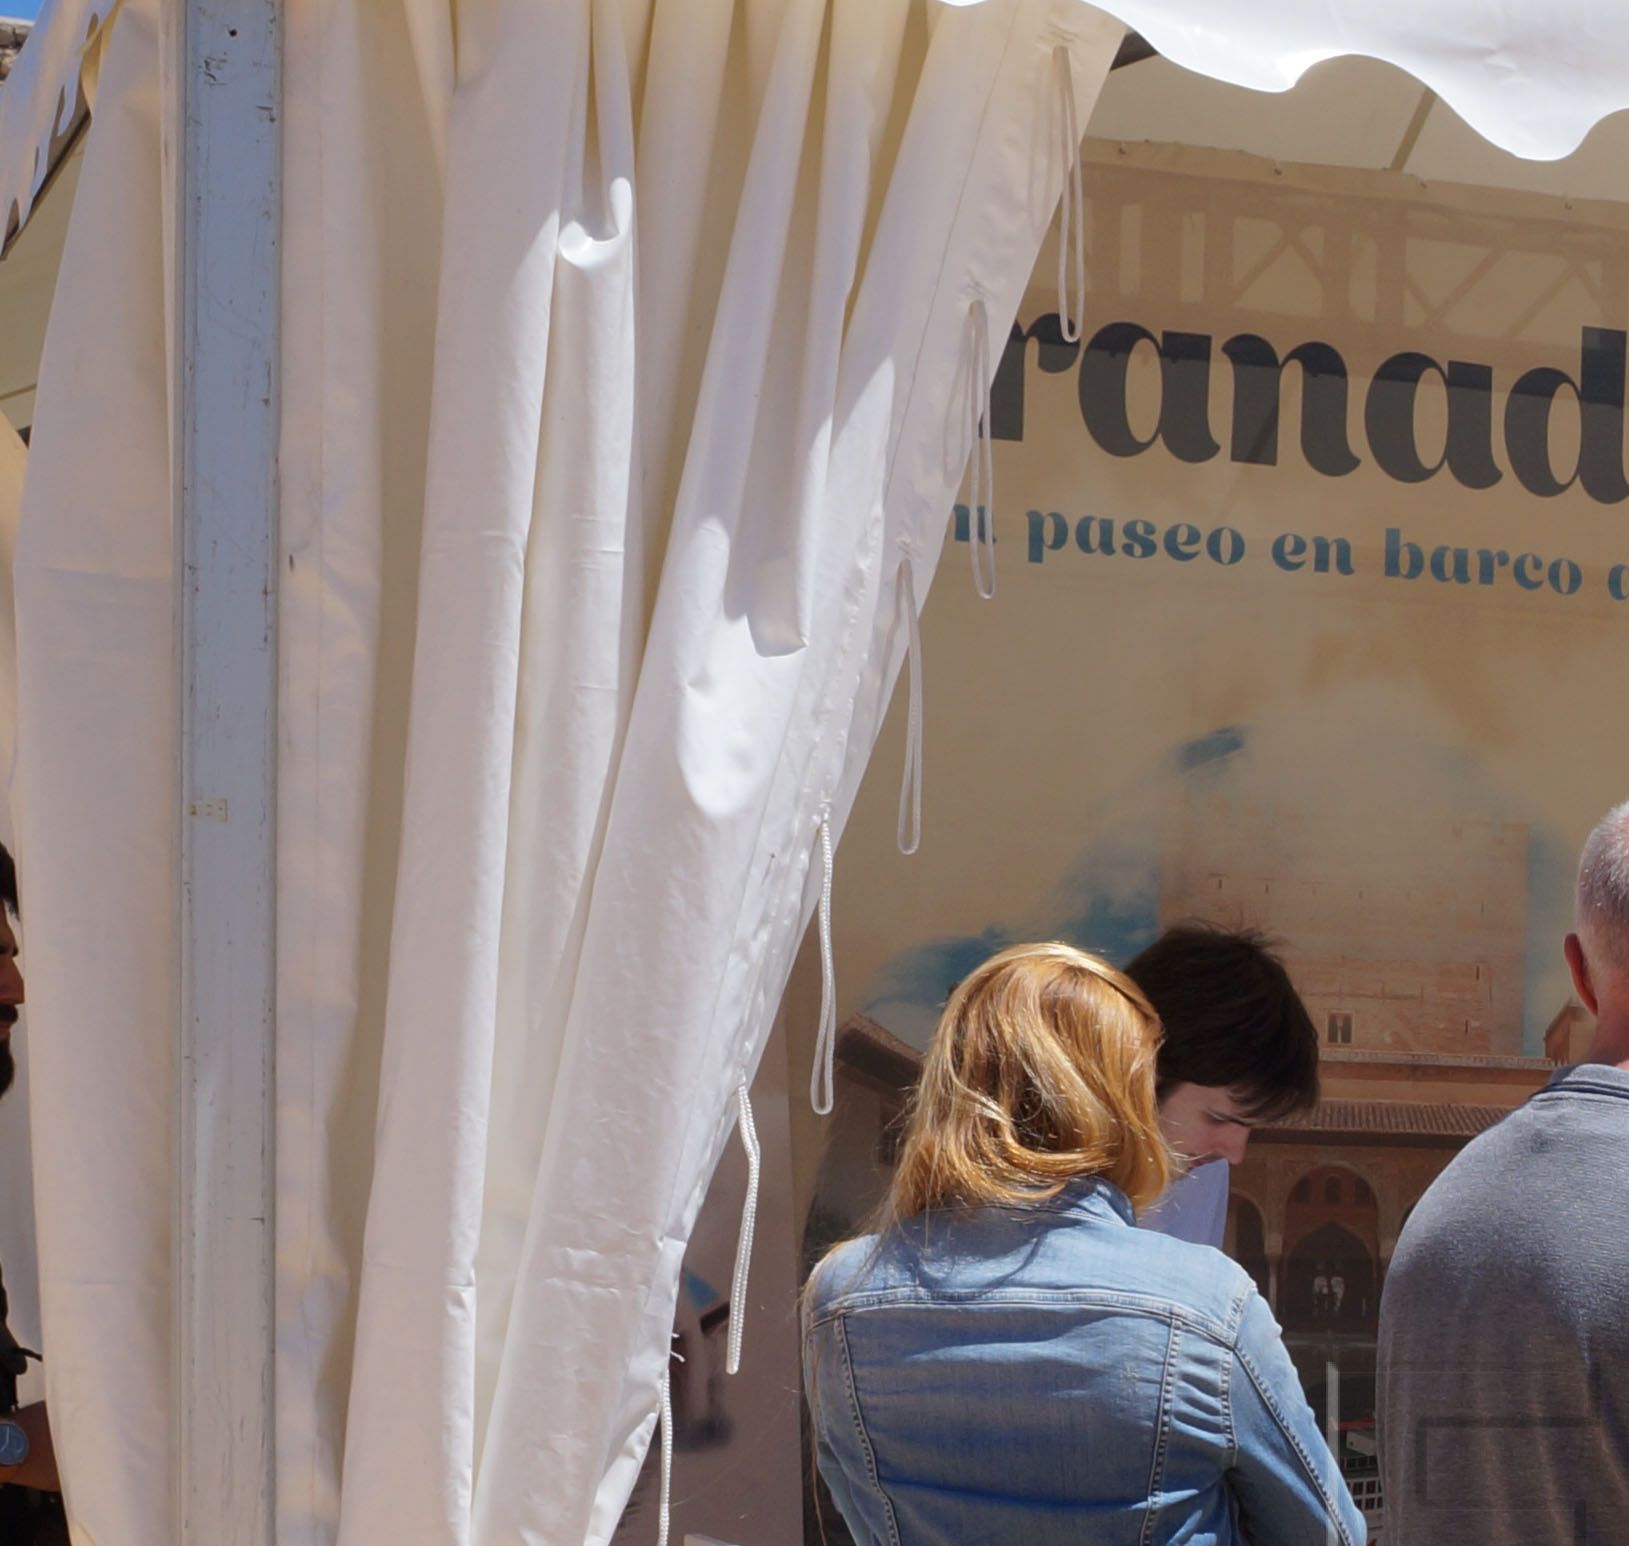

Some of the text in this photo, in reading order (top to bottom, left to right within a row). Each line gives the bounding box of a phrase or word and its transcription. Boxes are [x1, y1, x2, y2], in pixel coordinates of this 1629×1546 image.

[1026, 509, 1246, 565] paseo
[1271, 530, 1355, 577] en
[1384, 527, 1582, 595] barco
